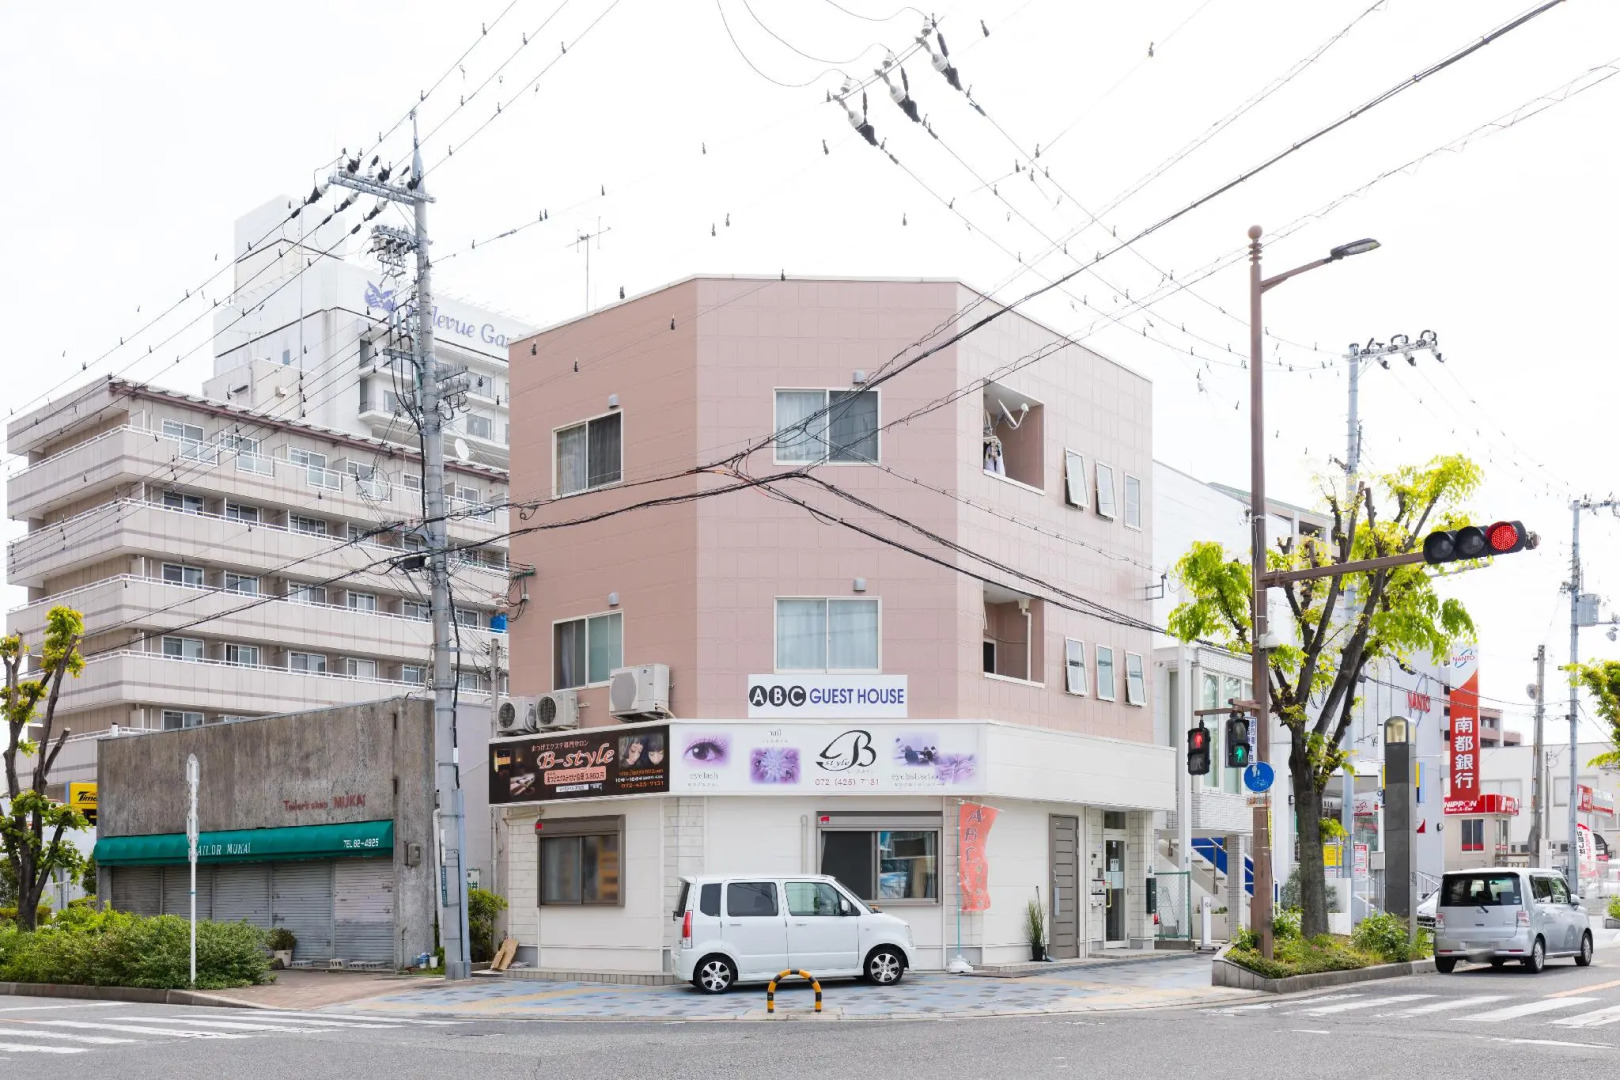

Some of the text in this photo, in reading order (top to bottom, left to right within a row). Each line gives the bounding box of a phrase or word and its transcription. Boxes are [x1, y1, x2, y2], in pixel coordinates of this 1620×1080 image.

[809, 688, 853, 704] GUEST
[857, 688, 904, 704] HOUSE
[1406, 690, 1430, 713] NANTO
[537, 742, 615, 770] B-style
[1455, 716, 1474, 789] 南都銀行
[333, 794, 366, 809] MUKAI
[1444, 800, 1477, 808] NIPPON
[193, 845, 222, 858] AILOR
[227, 842, 251, 856] MUKAI
